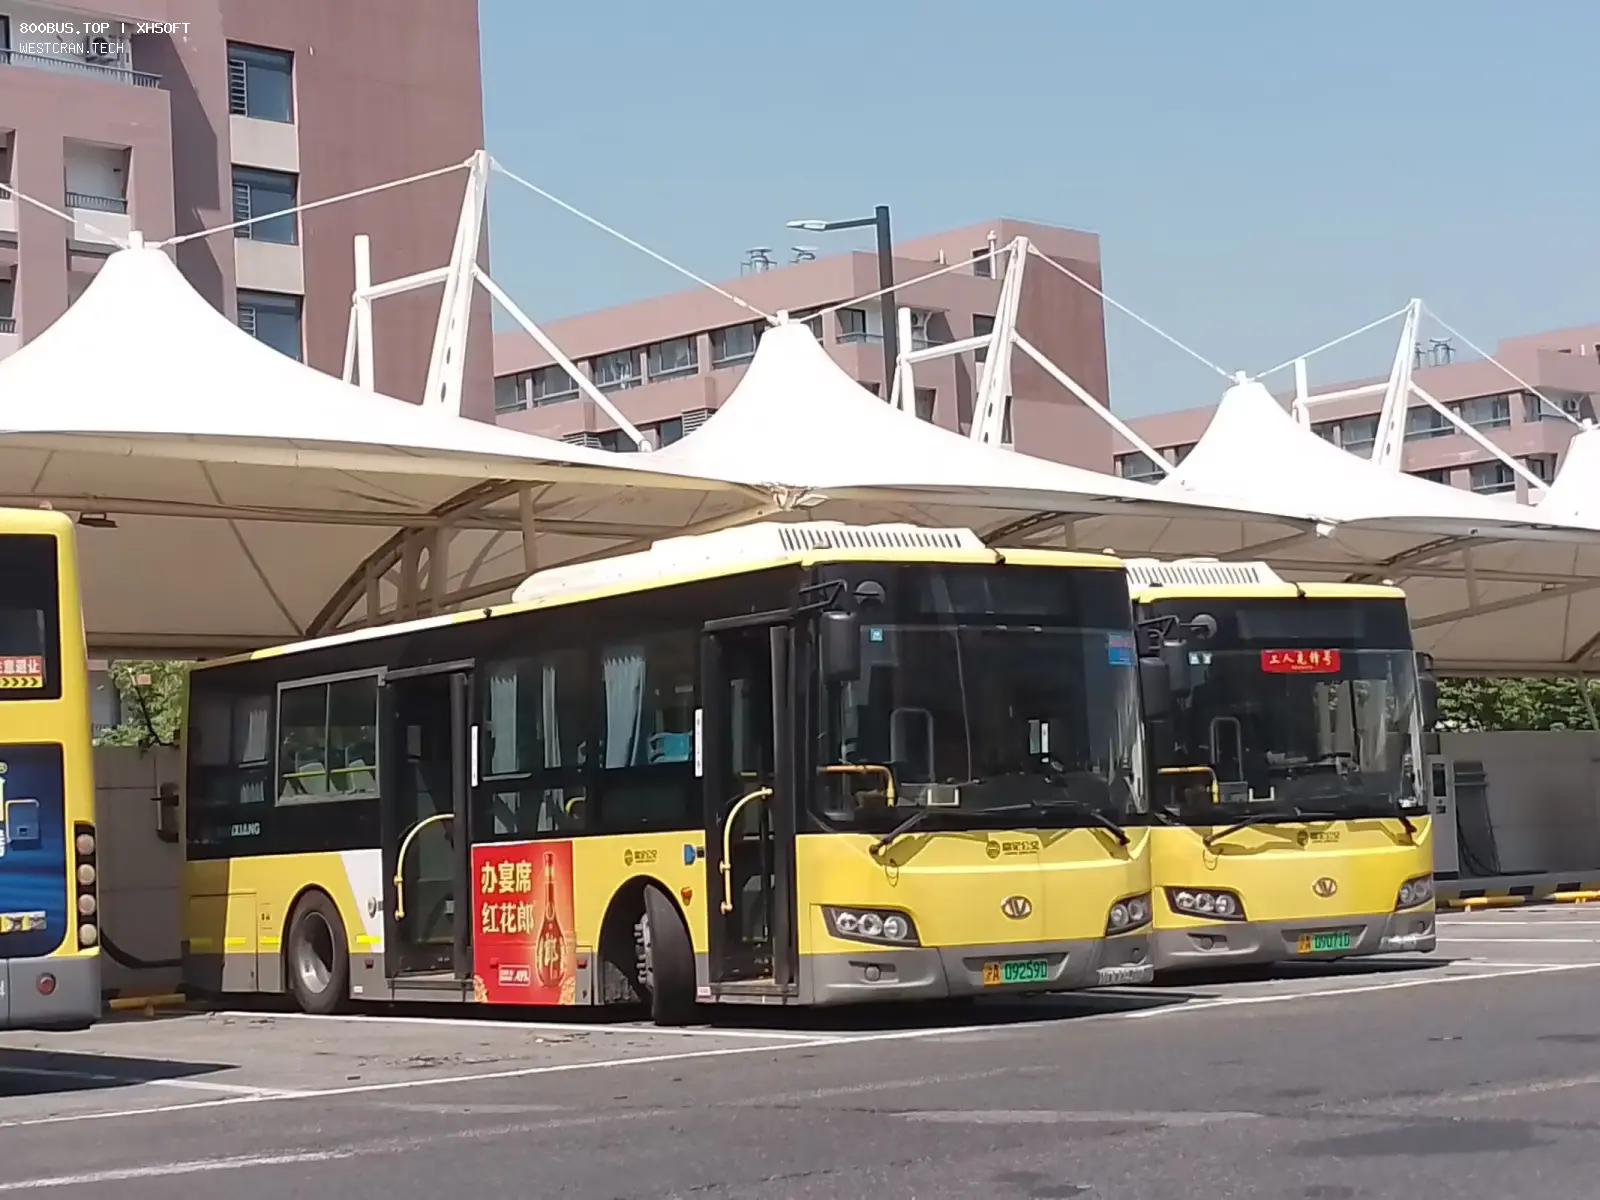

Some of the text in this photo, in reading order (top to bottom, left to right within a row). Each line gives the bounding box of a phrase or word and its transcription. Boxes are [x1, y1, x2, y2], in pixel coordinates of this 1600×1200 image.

[481, 860, 533, 894] 办宴席
[481, 901, 535, 935] 红花郎
